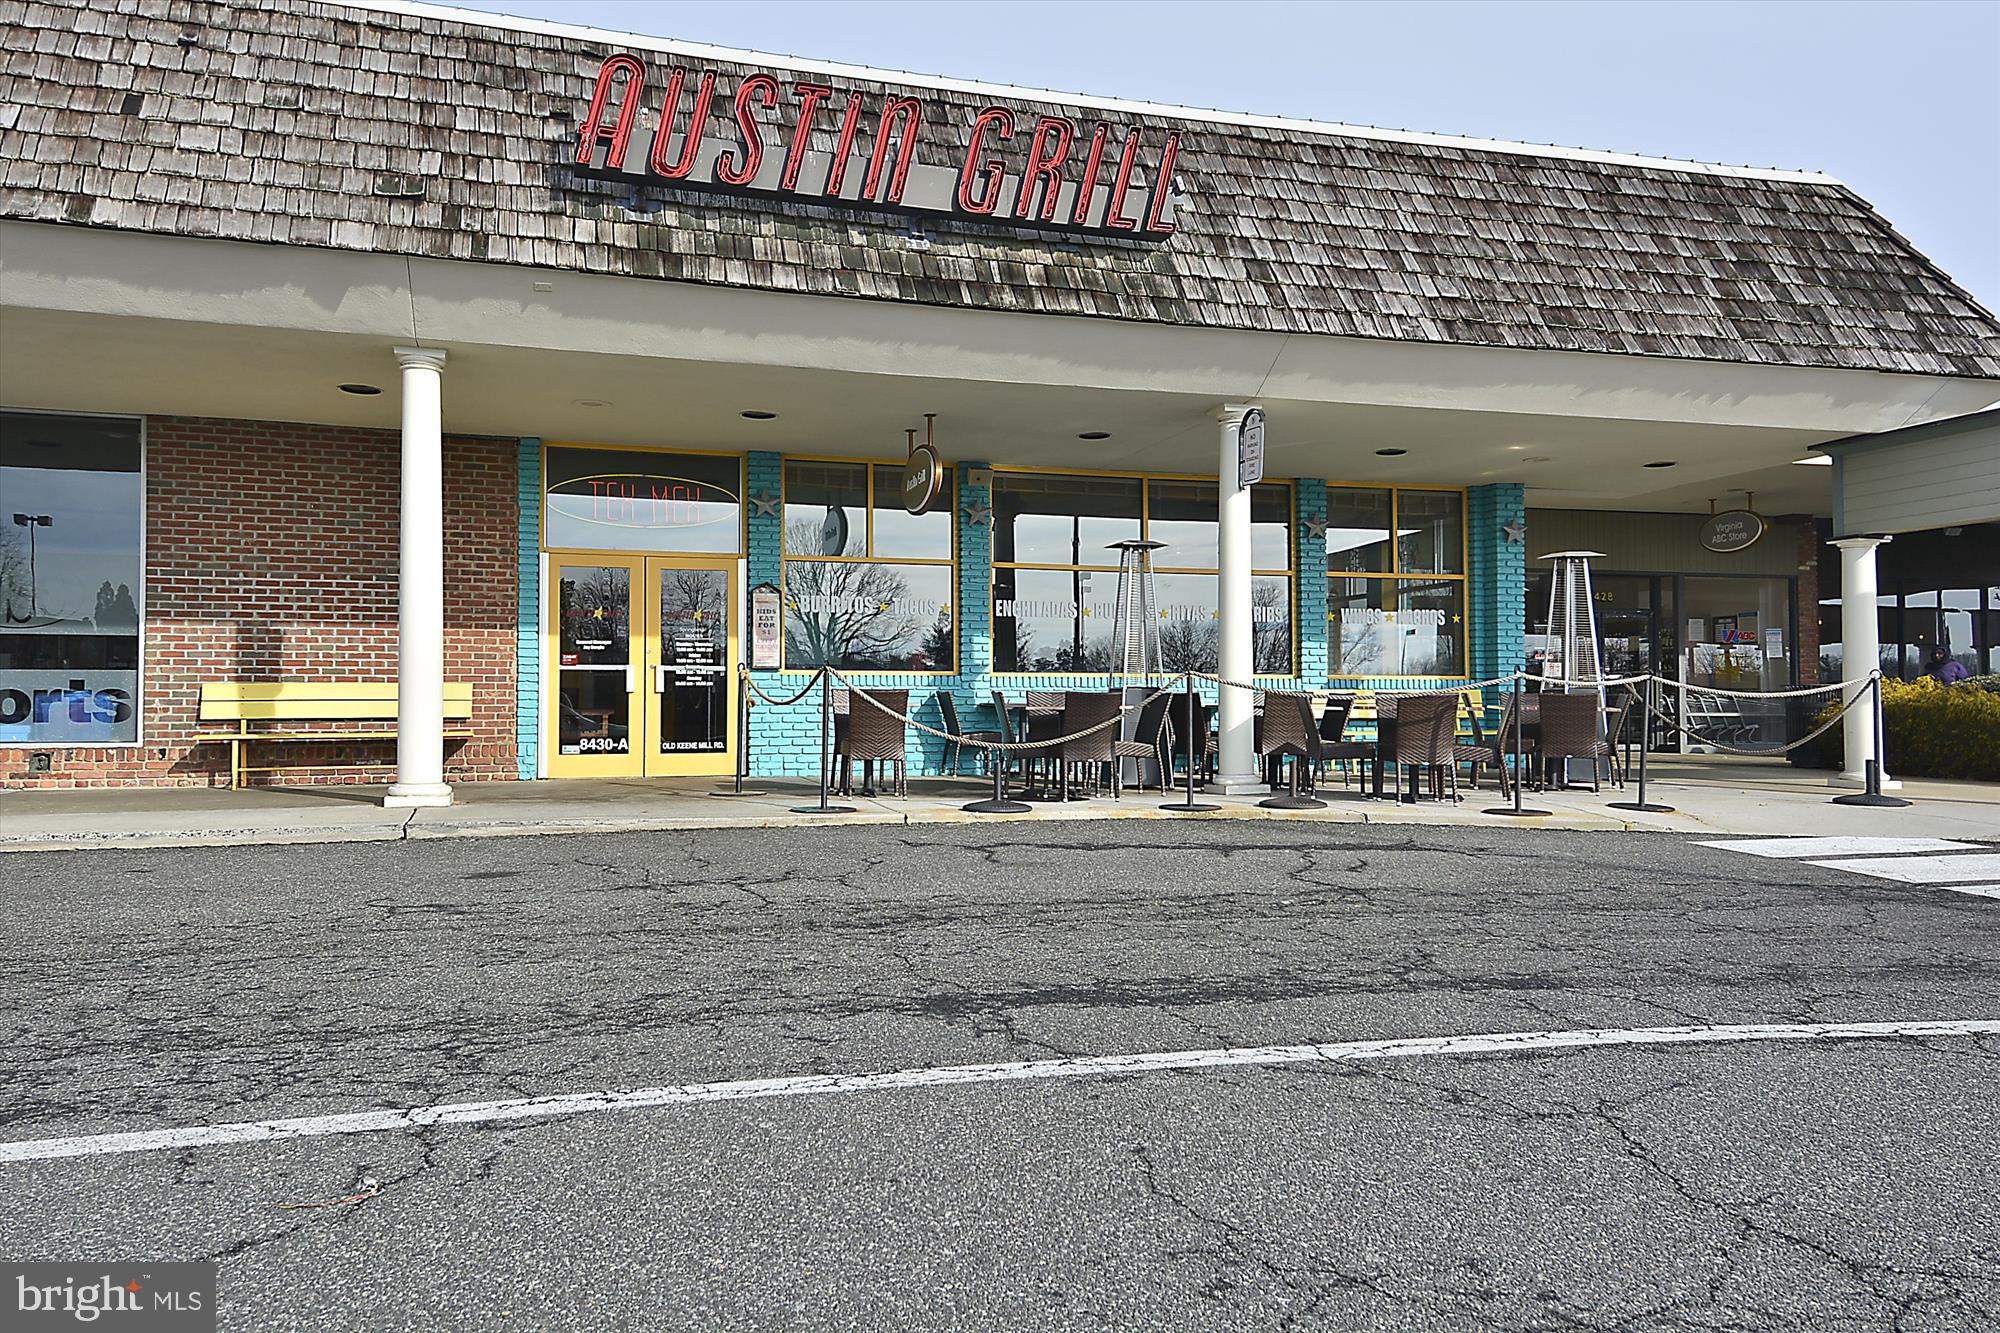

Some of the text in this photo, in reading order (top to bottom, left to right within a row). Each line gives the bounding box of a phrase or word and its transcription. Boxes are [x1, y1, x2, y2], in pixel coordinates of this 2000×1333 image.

[576, 52, 1183, 234] AUSTIN GRILL
[588, 480, 701, 524] TEX MEX
[1715, 520, 1743, 533] Virginia
[1712, 532, 1748, 543] ABC Store
[800, 595, 936, 616] BURRITOS TACOS
[995, 599, 1078, 618] ENCHILADAS
[1253, 606, 1282, 623] RIBS
[1340, 608, 1446, 626] WINGS NACHOS
[1737, 631, 1756, 641] ABC
[0, 680, 132, 724] orts
[579, 738, 629, 751] 8430-A
[662, 741, 675, 750] OLD
[676, 741, 698, 750] KEENE
